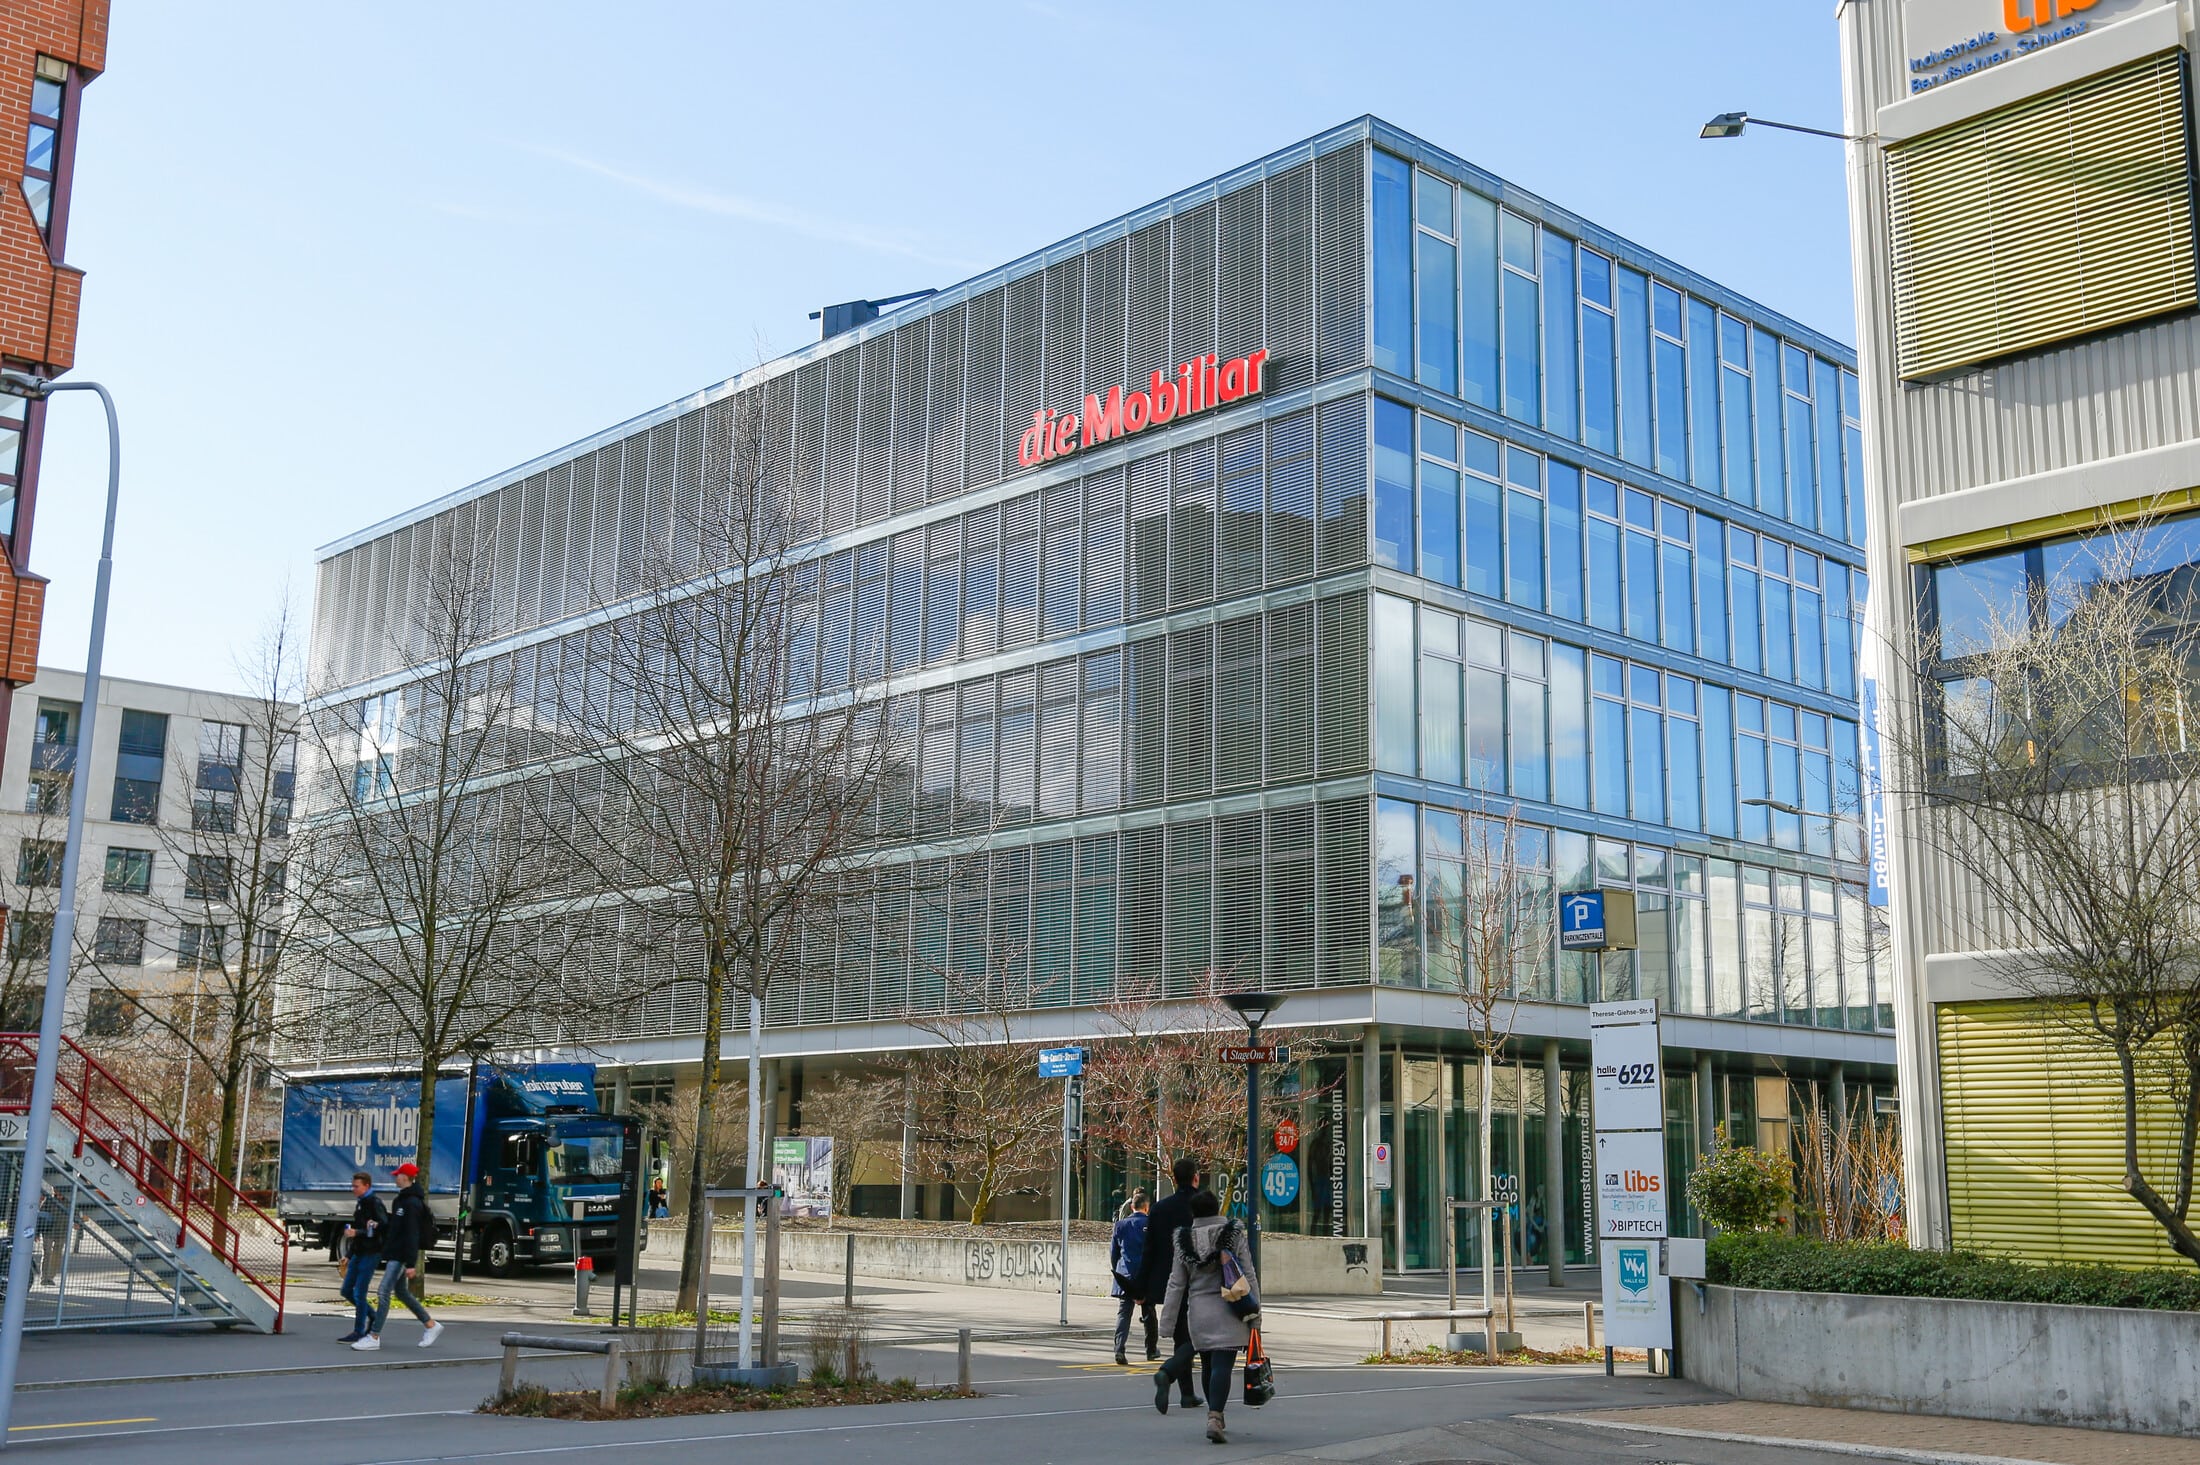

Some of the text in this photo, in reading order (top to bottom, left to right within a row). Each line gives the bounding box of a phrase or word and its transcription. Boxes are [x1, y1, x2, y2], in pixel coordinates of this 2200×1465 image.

[1910, 31, 1998, 73] Industrielle
[1911, 20, 2090, 94] Berufslehren Schweiz
[1574, 904, 1589, 929] P
[1564, 931, 1603, 943] PARKINGZENTRALE
[1592, 1008, 1648, 1018] Therese-Giehse-Str.
[1596, 1063, 1655, 1085] halle 622
[1279, 1135, 1295, 1147] 24/7
[1579, 1097, 1593, 1256] www.nonstopgym.com
[1624, 1170, 1661, 1192] libs
[588, 1204, 612, 1212] MAN
[1617, 1220, 1663, 1232] BIPTECH
